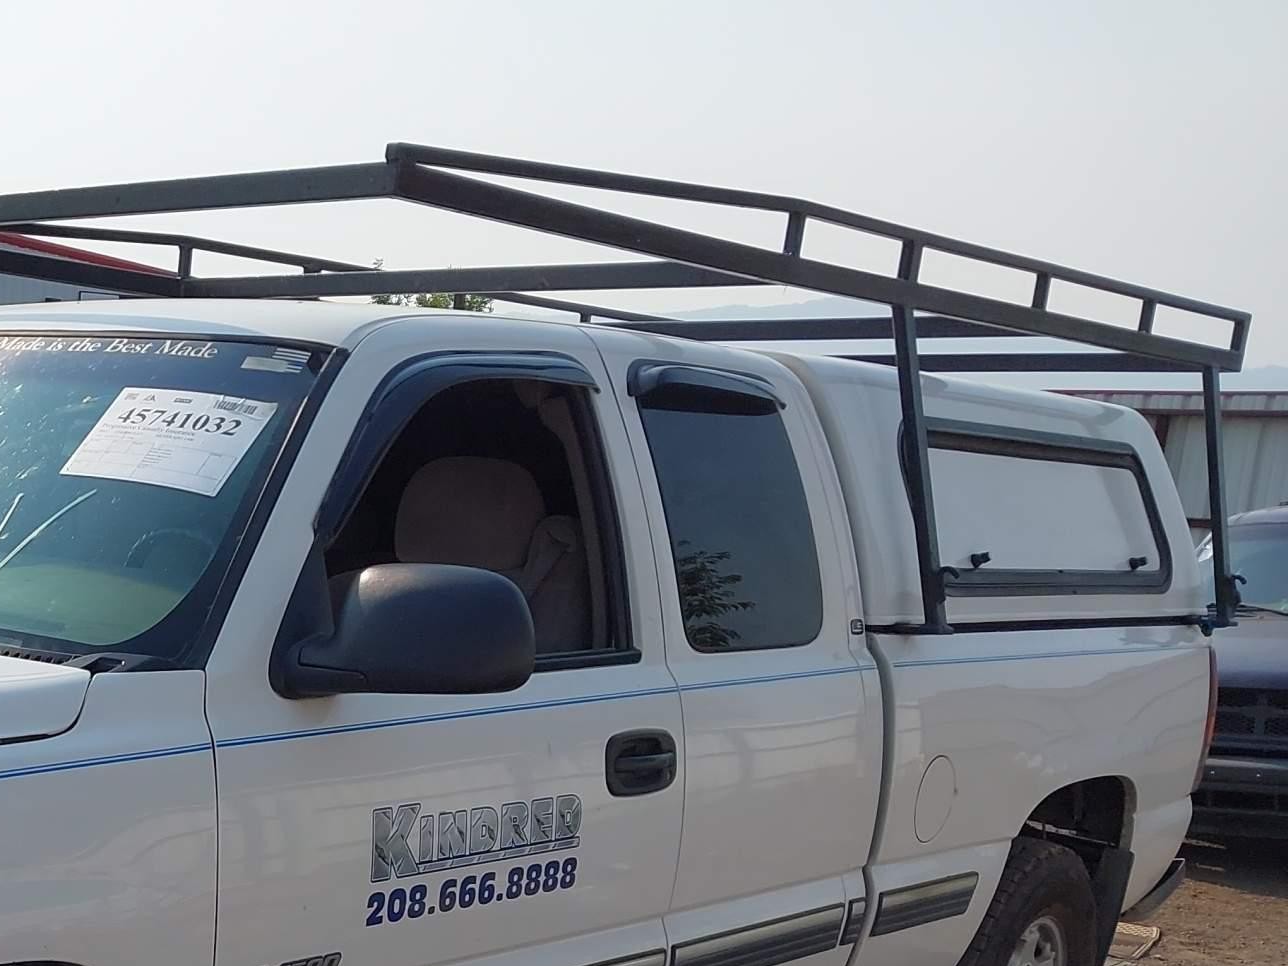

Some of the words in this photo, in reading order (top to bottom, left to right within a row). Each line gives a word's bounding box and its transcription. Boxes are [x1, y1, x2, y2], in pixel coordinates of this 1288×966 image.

[46, 337, 69, 351] is
[68, 338, 102, 352] the
[104, 338, 153, 354] Best
[155, 340, 218, 358] Made
[117, 407, 242, 436] 45741032
[365, 857, 577, 927] 208.666.8888
